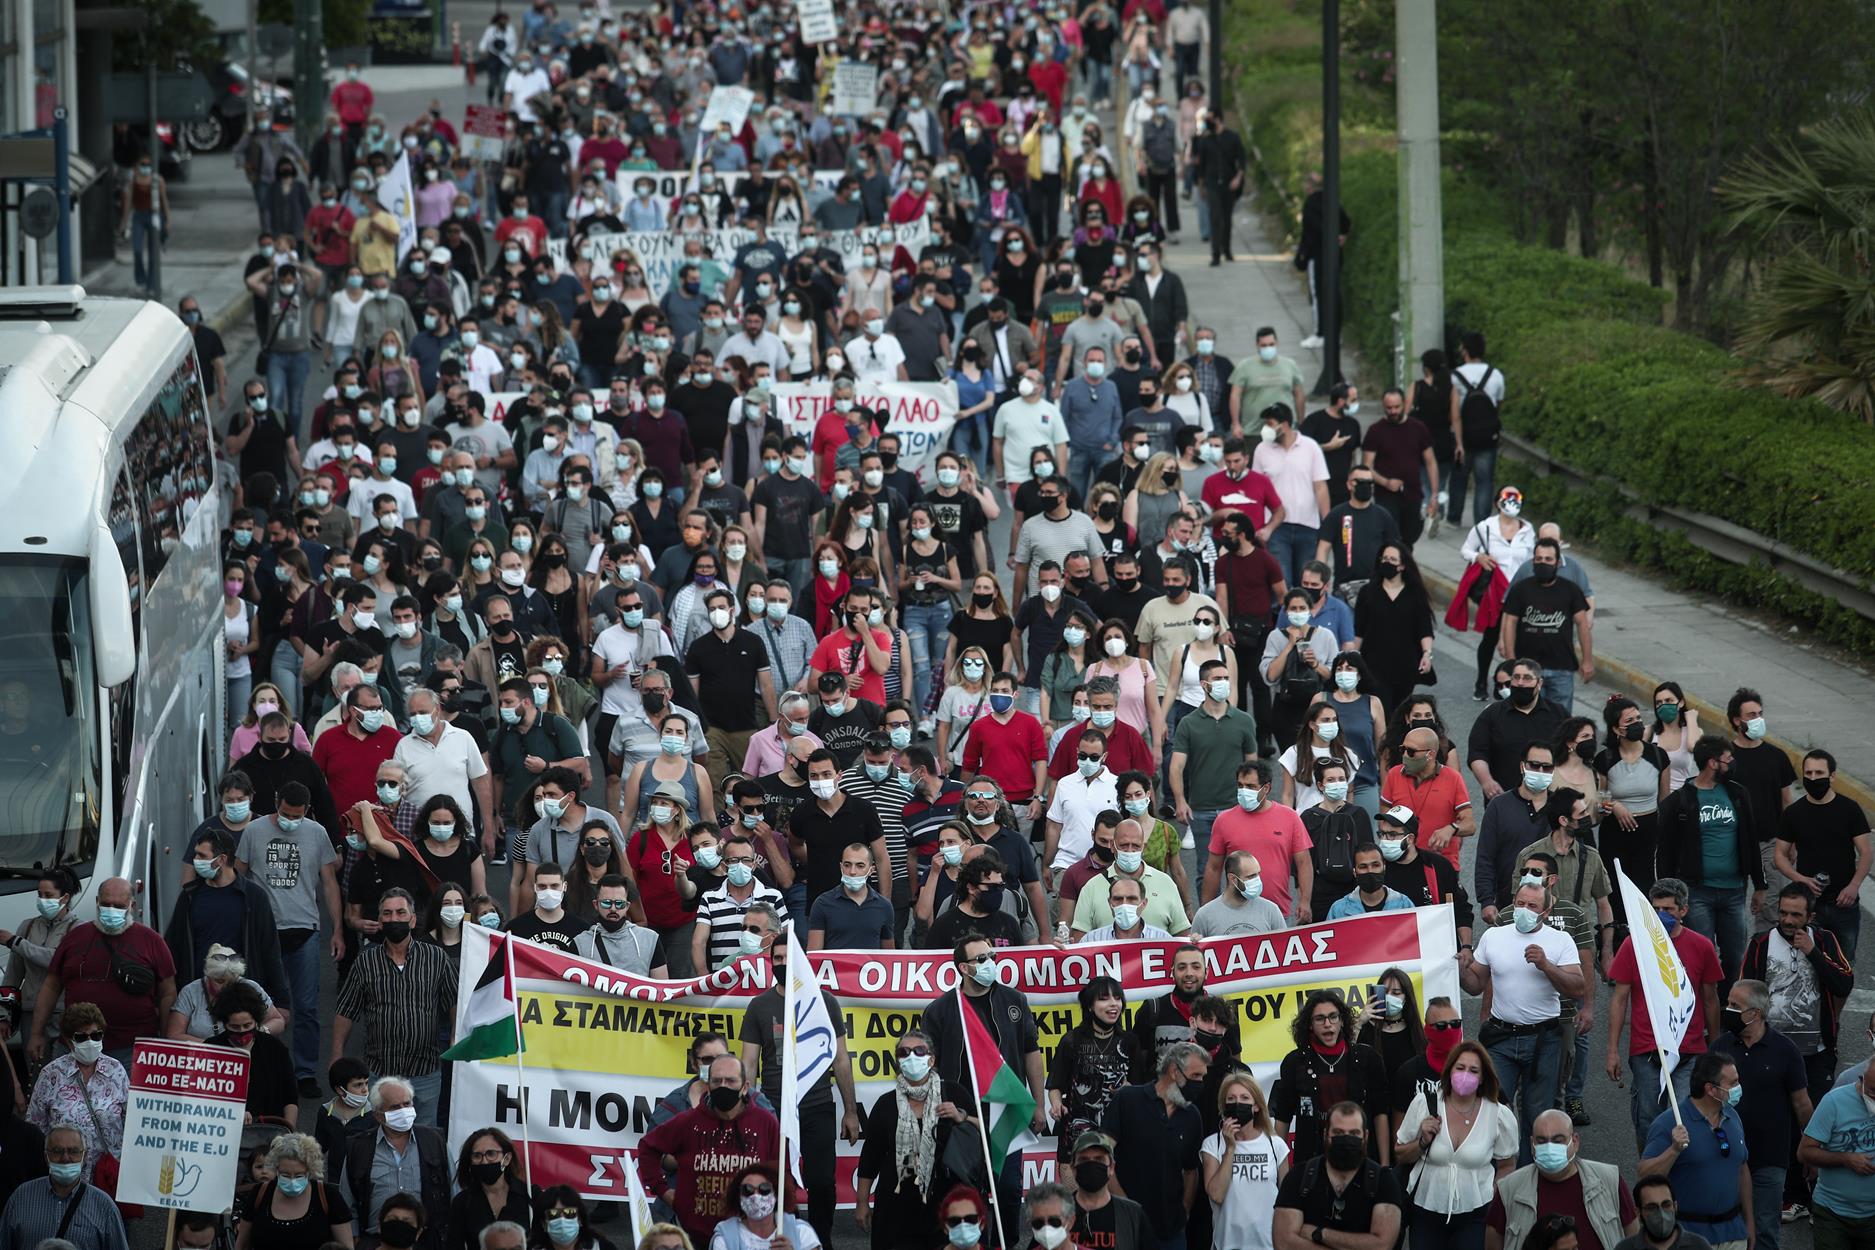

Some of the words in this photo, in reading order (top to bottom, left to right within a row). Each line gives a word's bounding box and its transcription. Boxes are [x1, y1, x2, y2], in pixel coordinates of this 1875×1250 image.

[894, 397, 940, 423] ΛΑΟ
[822, 725, 871, 746] LONSDALE
[830, 740, 862, 750] LONDON
[268, 853, 277, 861] 19
[268, 861, 300, 870] SPORTS
[288, 870, 298, 878] 14
[858, 951, 1123, 994] ΟΙΚΟΟΜΩΝ
[1141, 929, 1338, 982] ΕΛΑΔΑΣ
[552, 999, 735, 1041] ΣΤΑΜΑΤΗΣΕΙ
[136, 1050, 244, 1077] ΑΠΟΔΕΣΜΕΥΣΗ
[144, 1073, 168, 1086] ΑΠΟ
[171, 1073, 235, 1094] ΕΕ-ΝΑΤΟ
[135, 1097, 237, 1121] WITHDRAWAL
[494, 1083, 530, 1125] Η
[141, 1116, 182, 1132] FROM
[186, 1122, 226, 1138] NATO
[134, 1134, 166, 1150] AND
[170, 1138, 199, 1153] THE
[203, 1142, 229, 1156] E.U
[1232, 1164, 1269, 1182] PACE
[159, 1197, 191, 1208] ΕΕΔΥΕ
